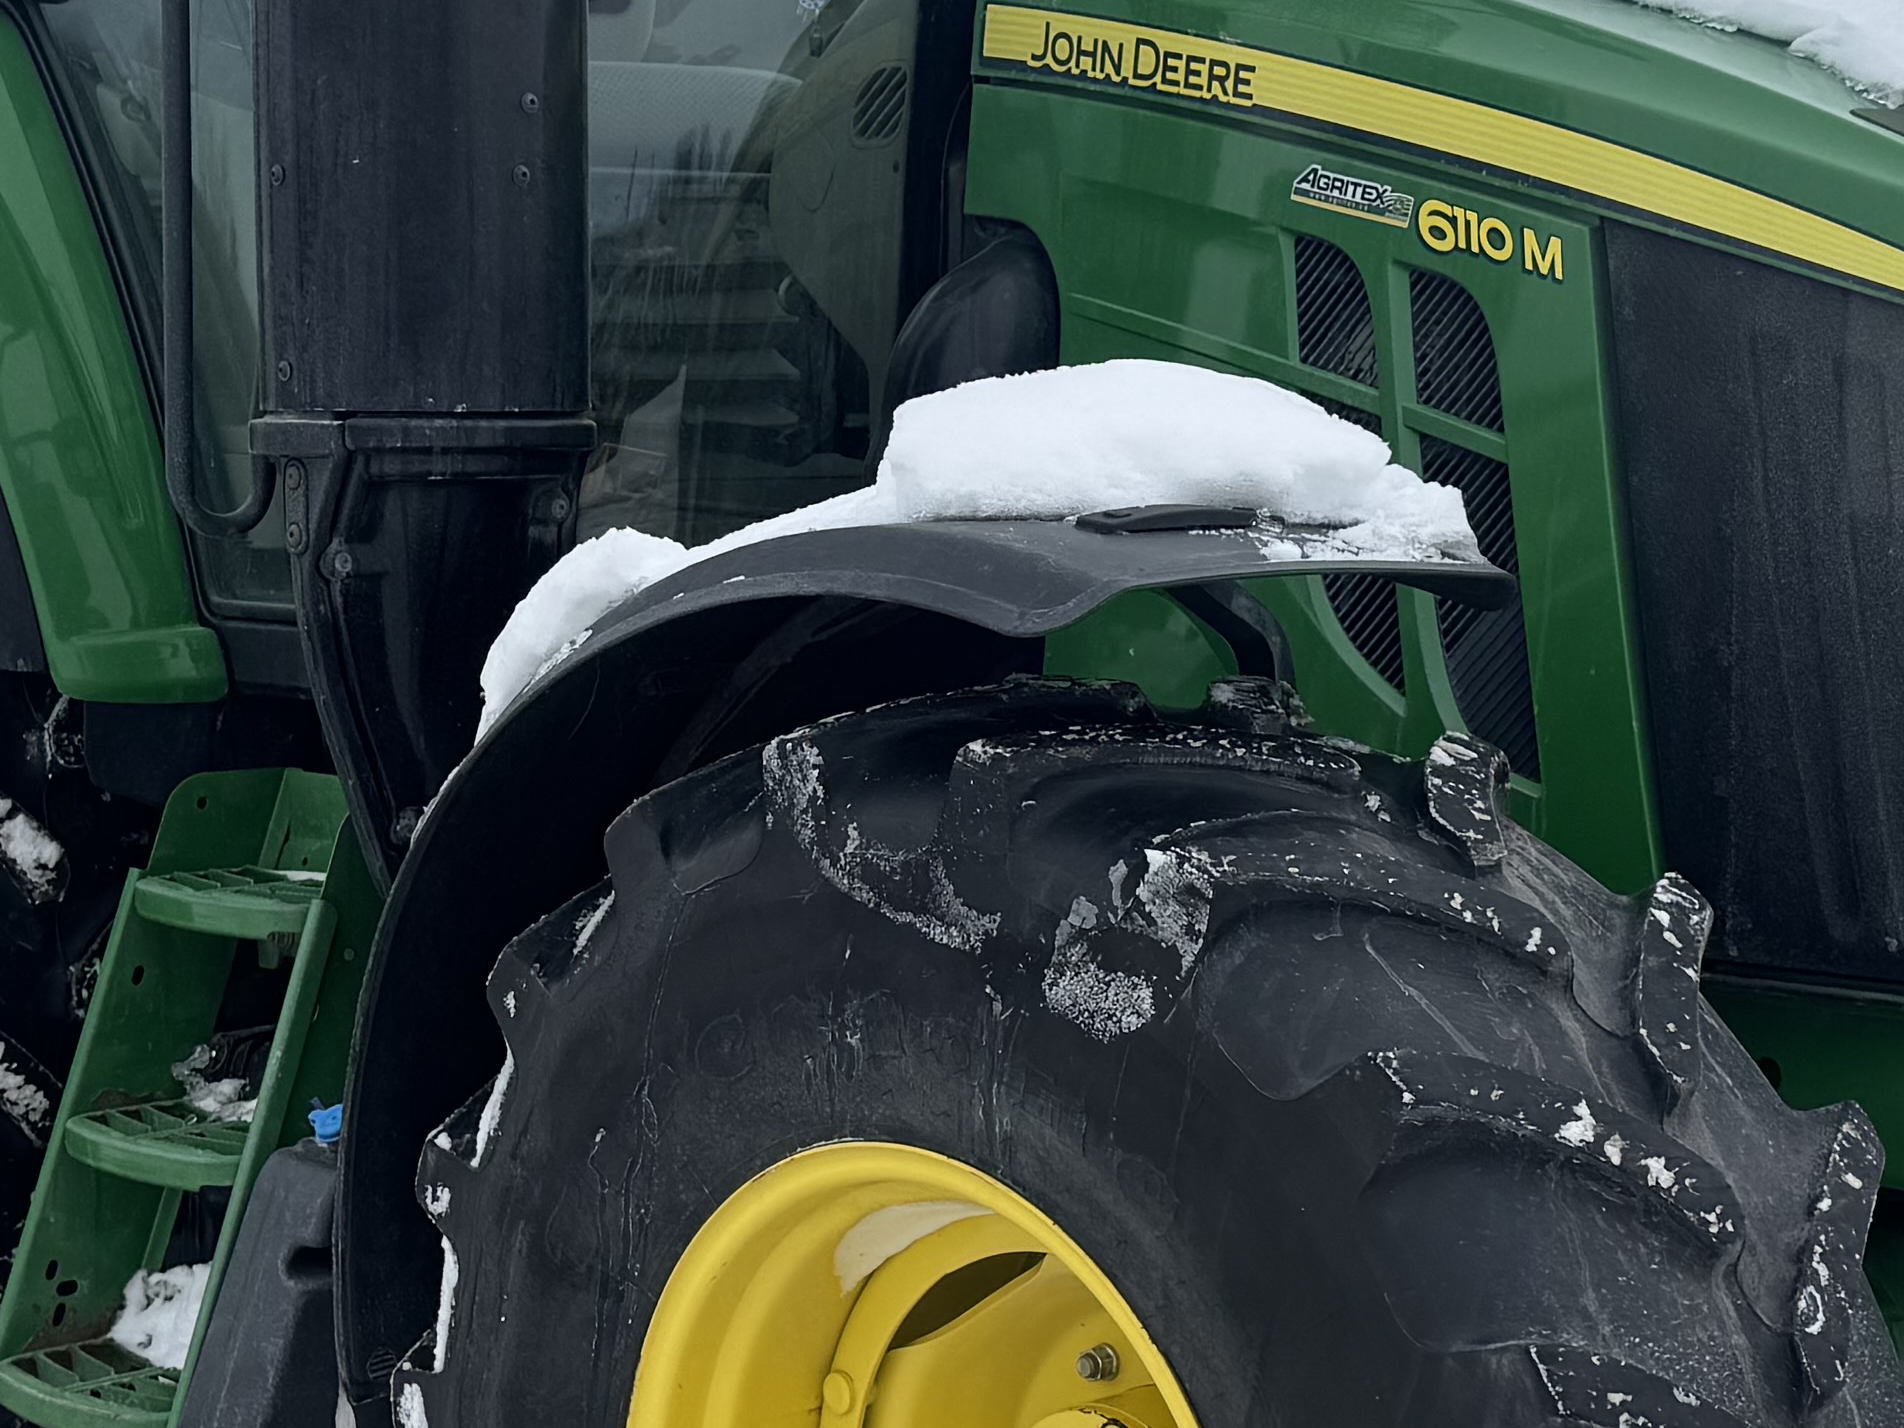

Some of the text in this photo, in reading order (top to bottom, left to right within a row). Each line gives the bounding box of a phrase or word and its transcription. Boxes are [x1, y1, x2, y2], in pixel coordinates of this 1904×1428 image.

[1030, 20, 1257, 102] JOHN DEERE
[1295, 166, 1389, 206] AGRITEX
[1418, 199, 1564, 281] 6110 M
